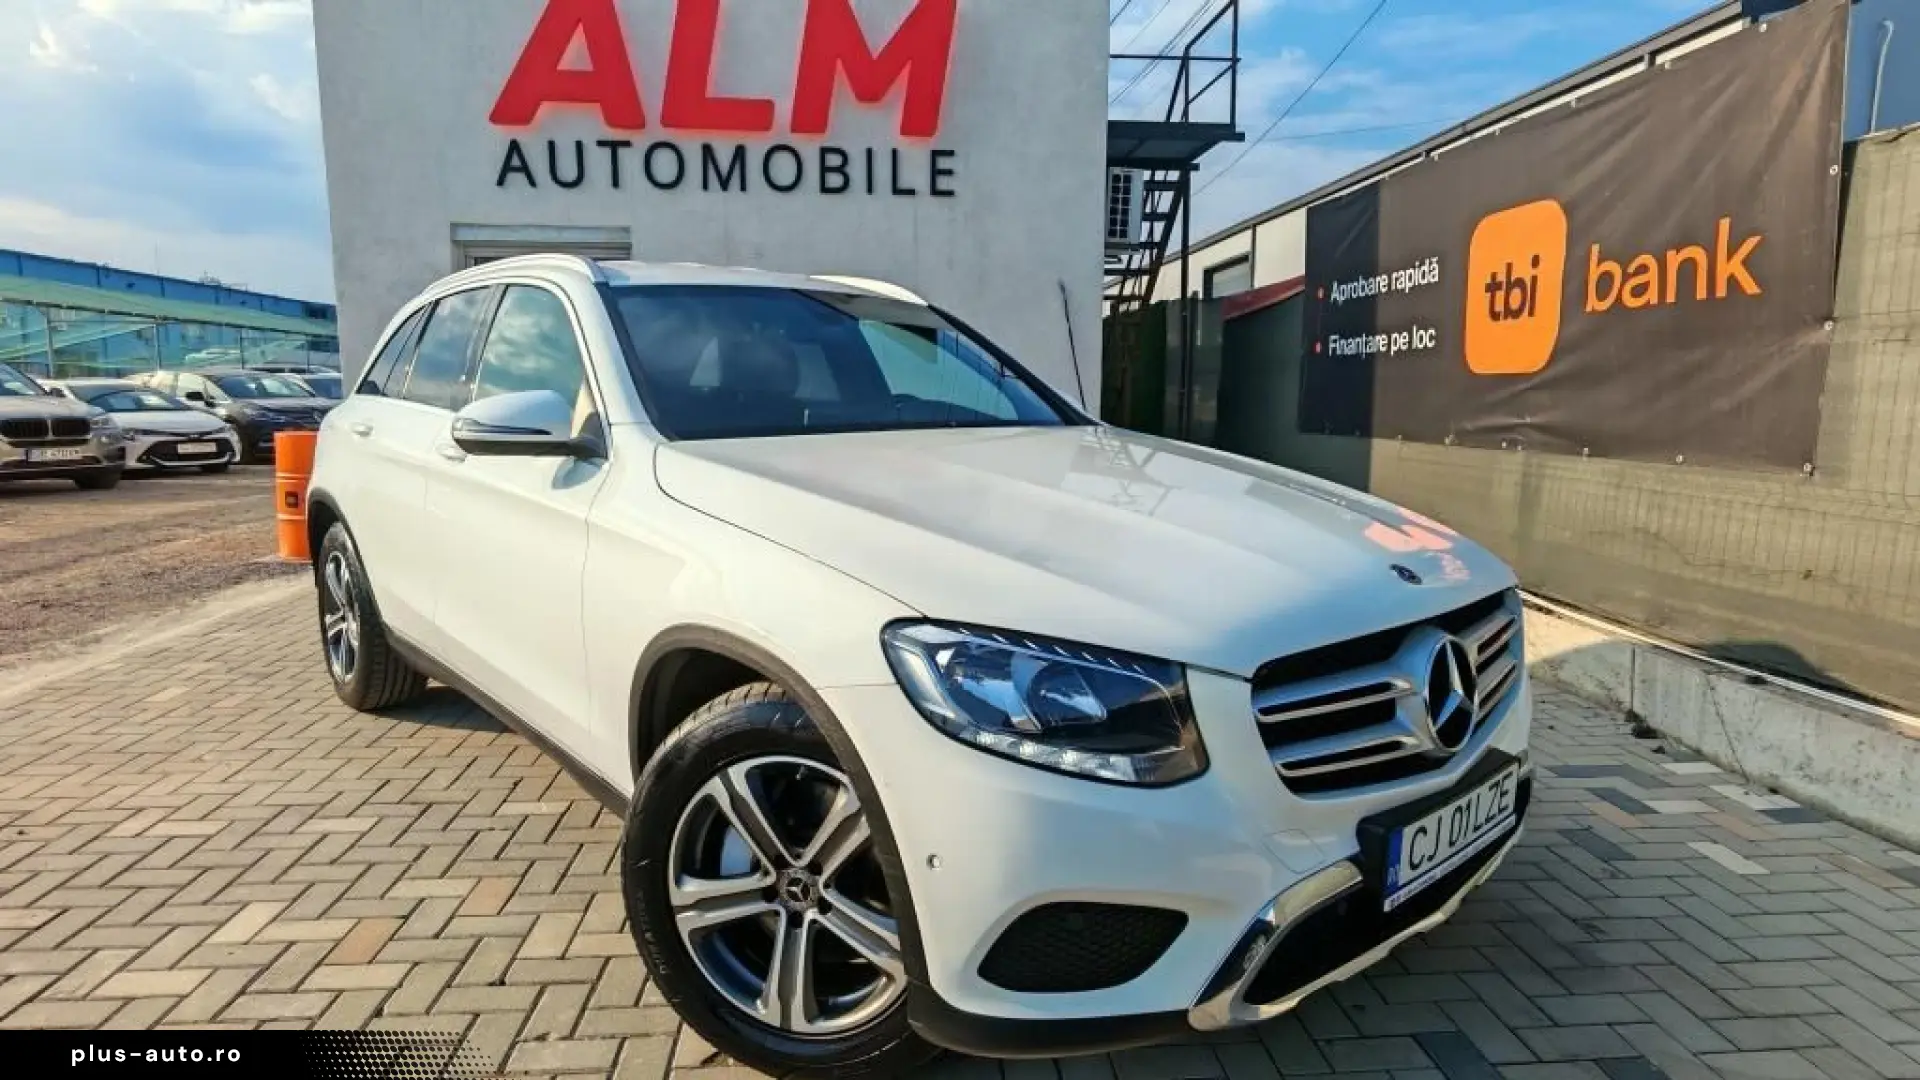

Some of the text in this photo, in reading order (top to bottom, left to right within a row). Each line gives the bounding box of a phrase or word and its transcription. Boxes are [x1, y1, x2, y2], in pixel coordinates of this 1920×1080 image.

[488, 0, 957, 137] ALM
[496, 138, 956, 196] AUTOMOBILE
[1330, 256, 1439, 306] Aprobare rapidă
[1485, 216, 1762, 321] tbi bank
[1328, 324, 1436, 359] Finanțare pe loc
[1409, 815, 1442, 871] CJ
